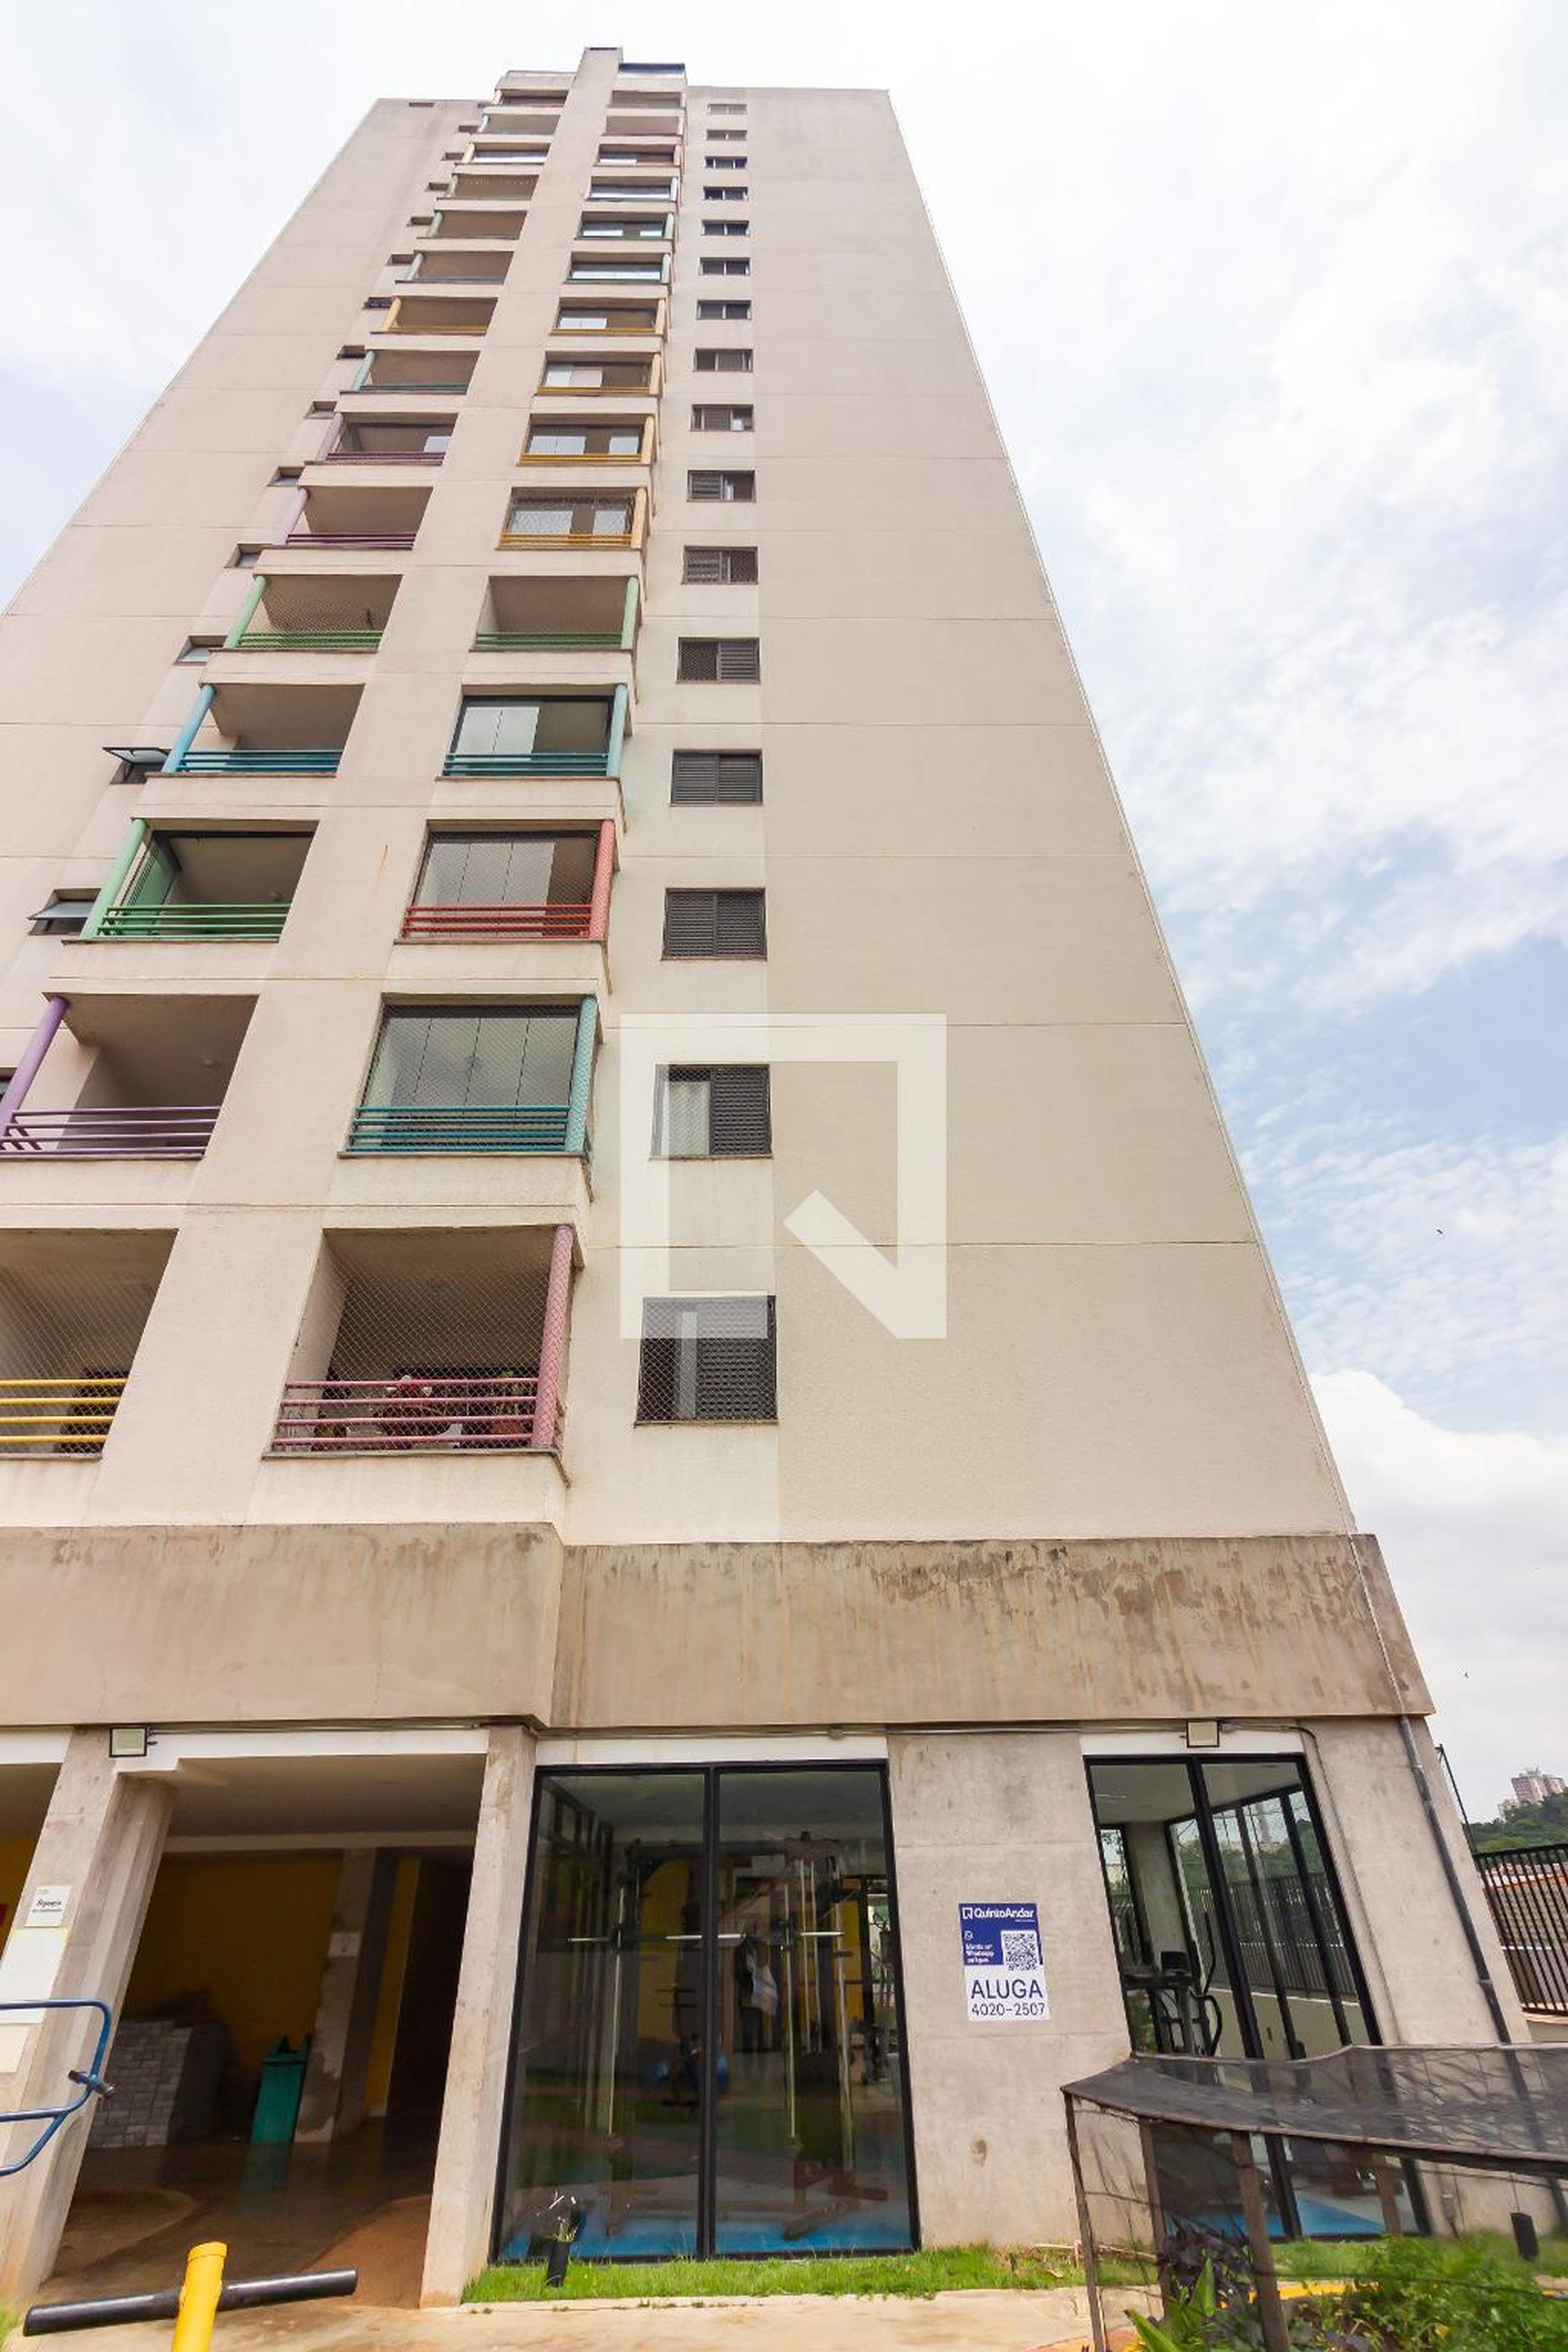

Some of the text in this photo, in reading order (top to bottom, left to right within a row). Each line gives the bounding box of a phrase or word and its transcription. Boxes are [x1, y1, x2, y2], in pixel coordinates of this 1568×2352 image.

[974, 1907, 1034, 1918] QuintoAndar
[971, 1979, 1043, 1999] ALUGA
[972, 2002, 1045, 2016] 4020-2507
